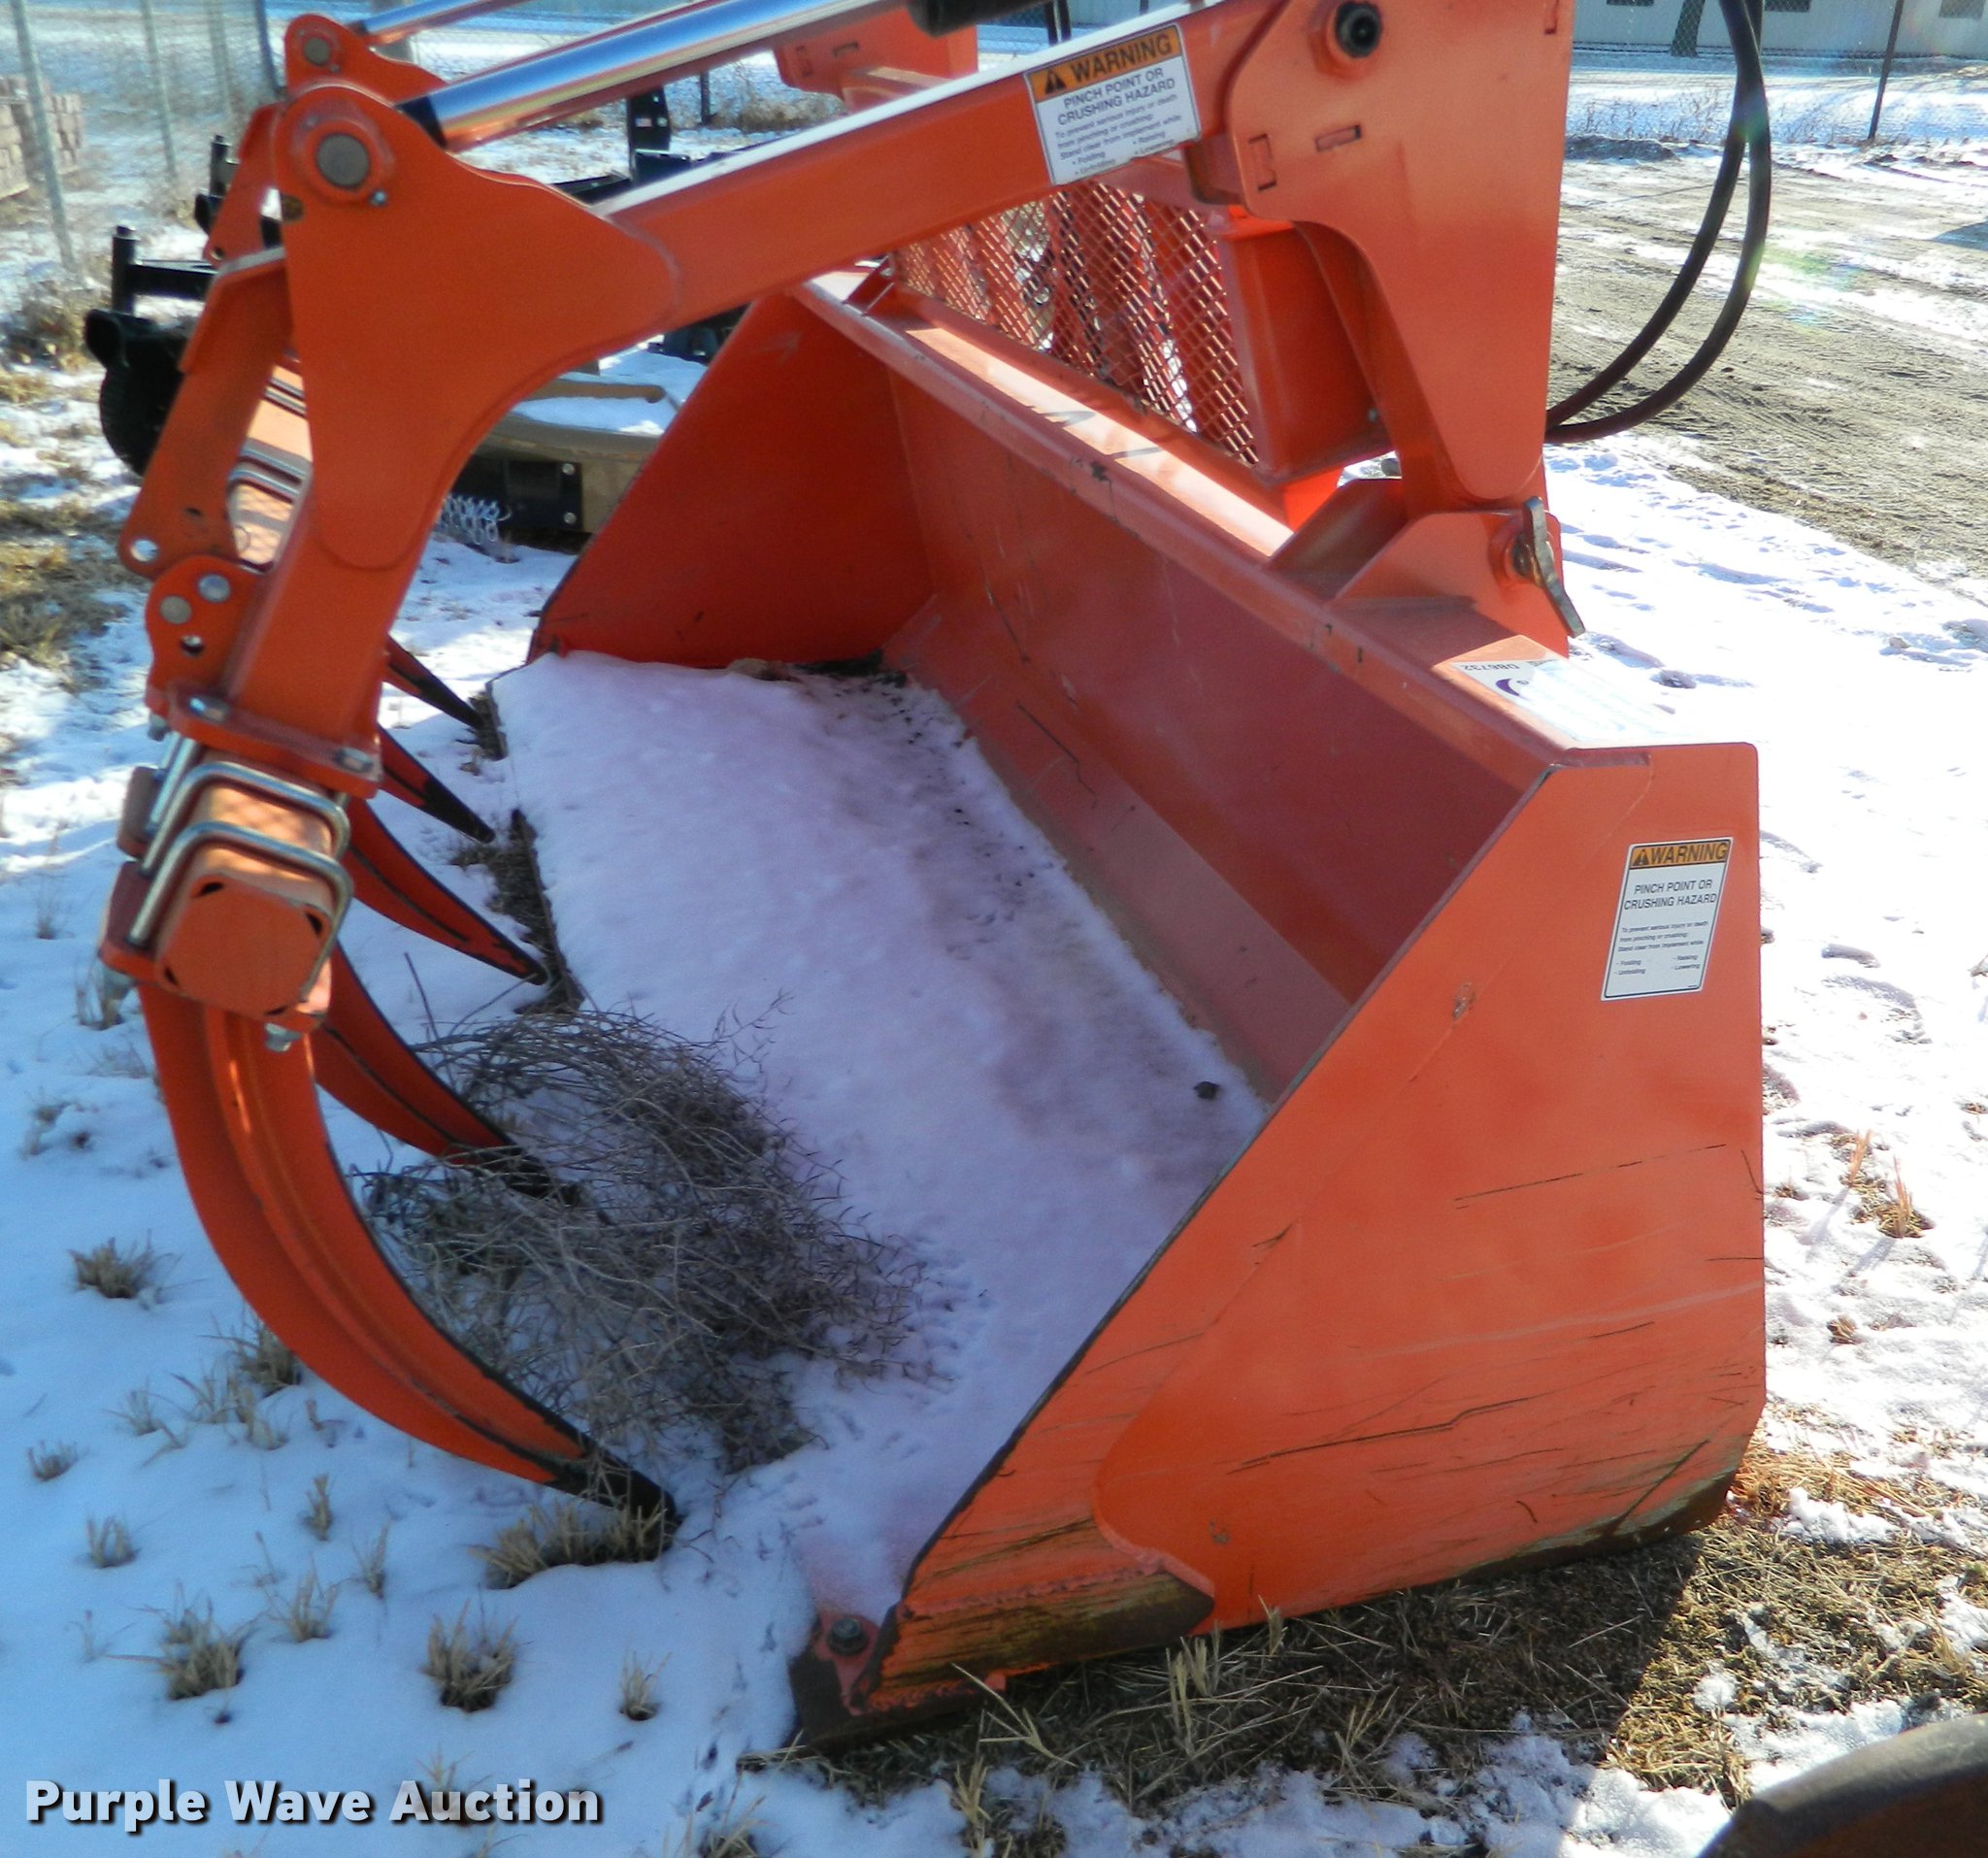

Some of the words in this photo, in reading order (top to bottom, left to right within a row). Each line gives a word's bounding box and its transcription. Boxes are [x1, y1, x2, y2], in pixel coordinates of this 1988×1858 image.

[1071, 34, 1173, 83] WARNING
[1064, 87, 1102, 109] PINCH
[1106, 75, 1141, 96] POINT
[1145, 68, 1163, 83] OR
[1058, 96, 1122, 125] CRUSHING
[1126, 78, 1176, 104] HAZARD
[1060, 149, 1081, 159] Stand
[1651, 843, 1729, 864] WARNING
[1634, 883, 1664, 894] PINCH
[1667, 880, 1696, 892] POINT
[1699, 879, 1712, 889] OR
[1624, 897, 1674, 911] CRUSHING
[1676, 893, 1717, 906] HAZARD
